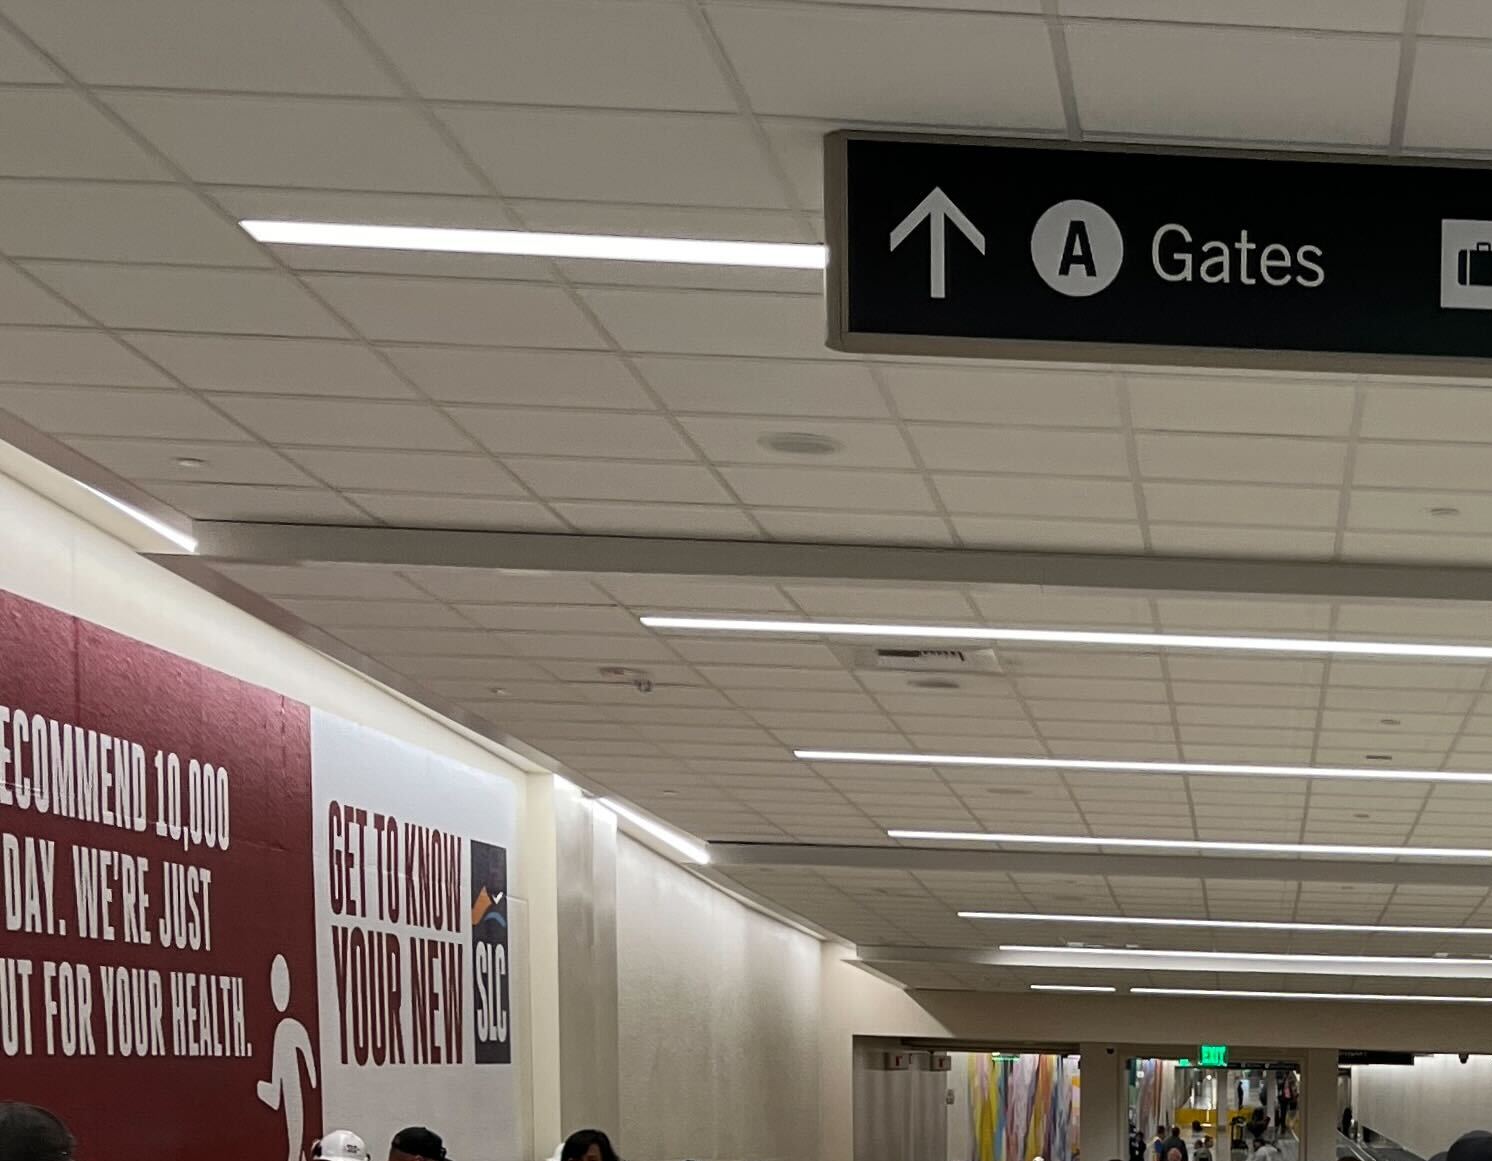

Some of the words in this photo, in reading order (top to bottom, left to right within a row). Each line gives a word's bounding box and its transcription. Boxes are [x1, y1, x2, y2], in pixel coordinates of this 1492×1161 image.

[1058, 220, 1097, 277] A
[1152, 223, 1326, 287] Gates
[155, 750, 230, 851] 10,000
[3, 832, 67, 936] DAY.
[72, 845, 151, 944] WE'RE
[159, 861, 211, 951] JUST
[329, 800, 367, 918] GET
[374, 813, 400, 923] TO
[405, 823, 462, 933] KNOW
[43, 961, 96, 1056] FOR
[100, 966, 166, 1056] YOUR
[170, 972, 253, 1057] HEALTH.
[332, 925, 406, 1066] YOUR
[410, 936, 463, 1064] NEW
[474, 941, 507, 1042] SLC
[1202, 1046, 1226, 1065] EXIT
